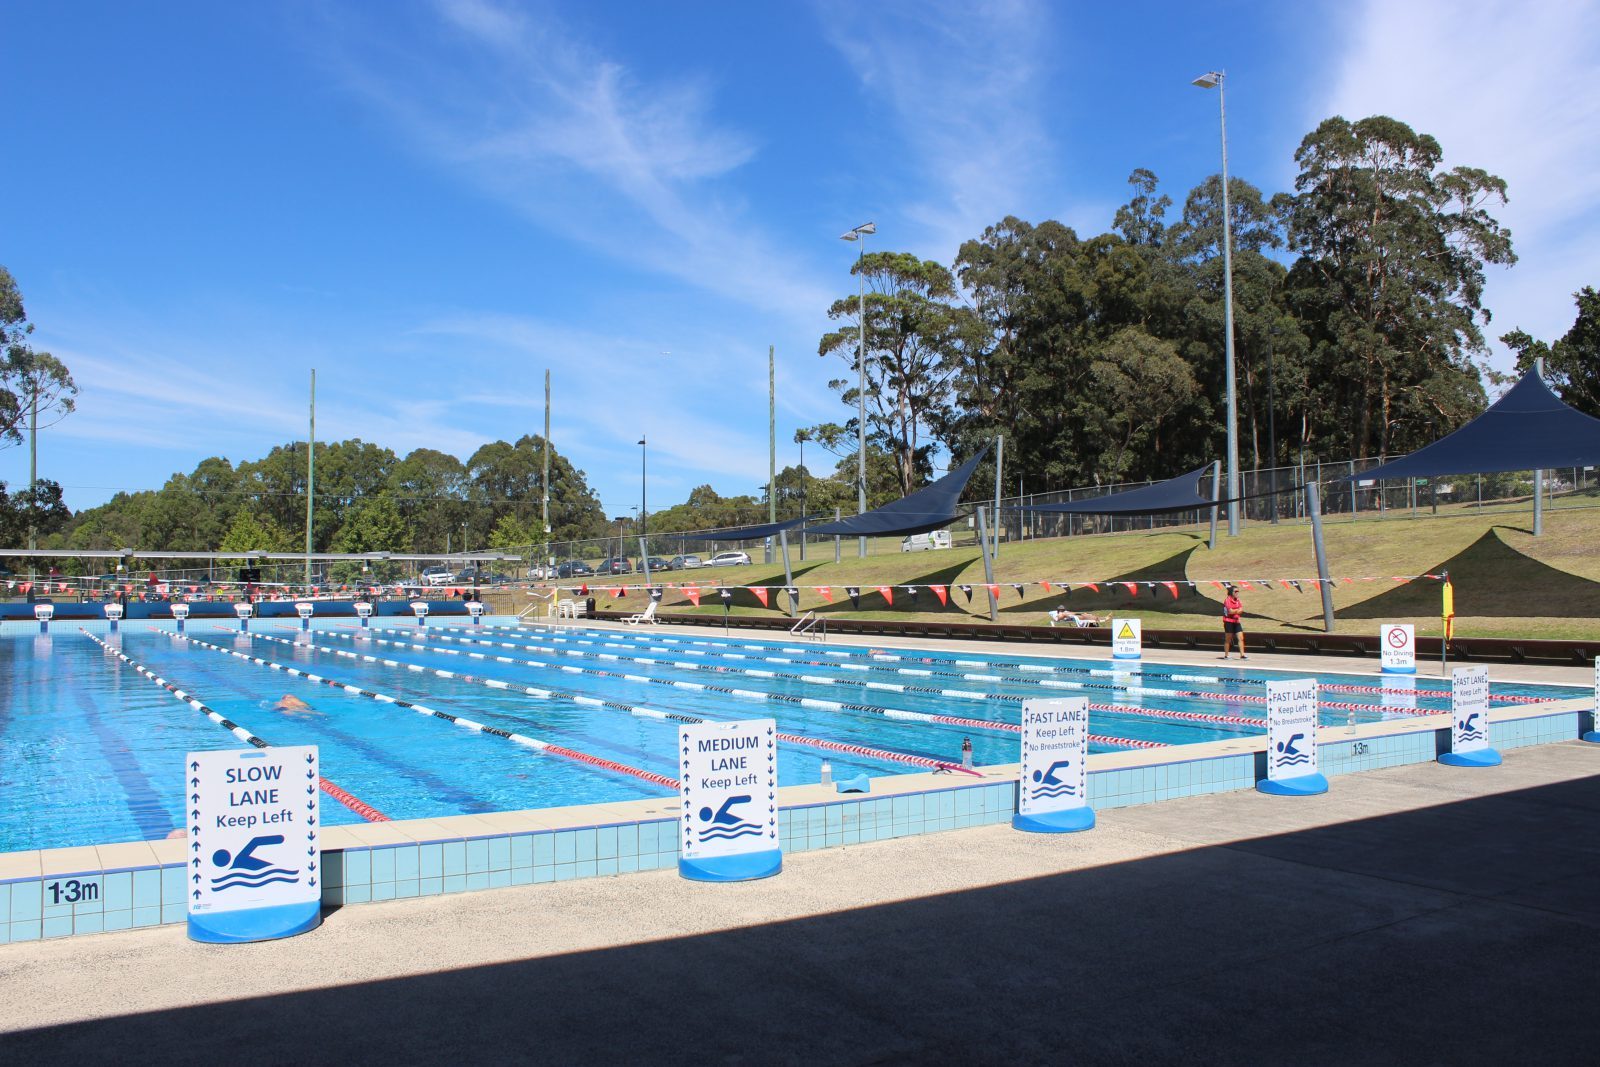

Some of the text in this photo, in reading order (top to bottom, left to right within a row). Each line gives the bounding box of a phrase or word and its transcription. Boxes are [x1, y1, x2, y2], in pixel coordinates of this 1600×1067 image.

[1457, 675, 1485, 687] FAST LANE
[1273, 690, 1312, 702] FAST LANE
[1460, 687, 1482, 697] Keep Left
[1278, 703, 1308, 715] Keep Left
[1030, 710, 1081, 724] FAST LANE
[1282, 716, 1312, 725] Breaststroke
[1036, 726, 1075, 739] Keep Left
[698, 735, 759, 753] MEDIUM
[1029, 740, 1081, 752] No Breaststroke
[711, 756, 748, 772] LANE
[225, 765, 282, 784] SLOW
[701, 773, 758, 790] Keep Left
[230, 788, 279, 807] LANE
[216, 808, 293, 829] Keep Left
